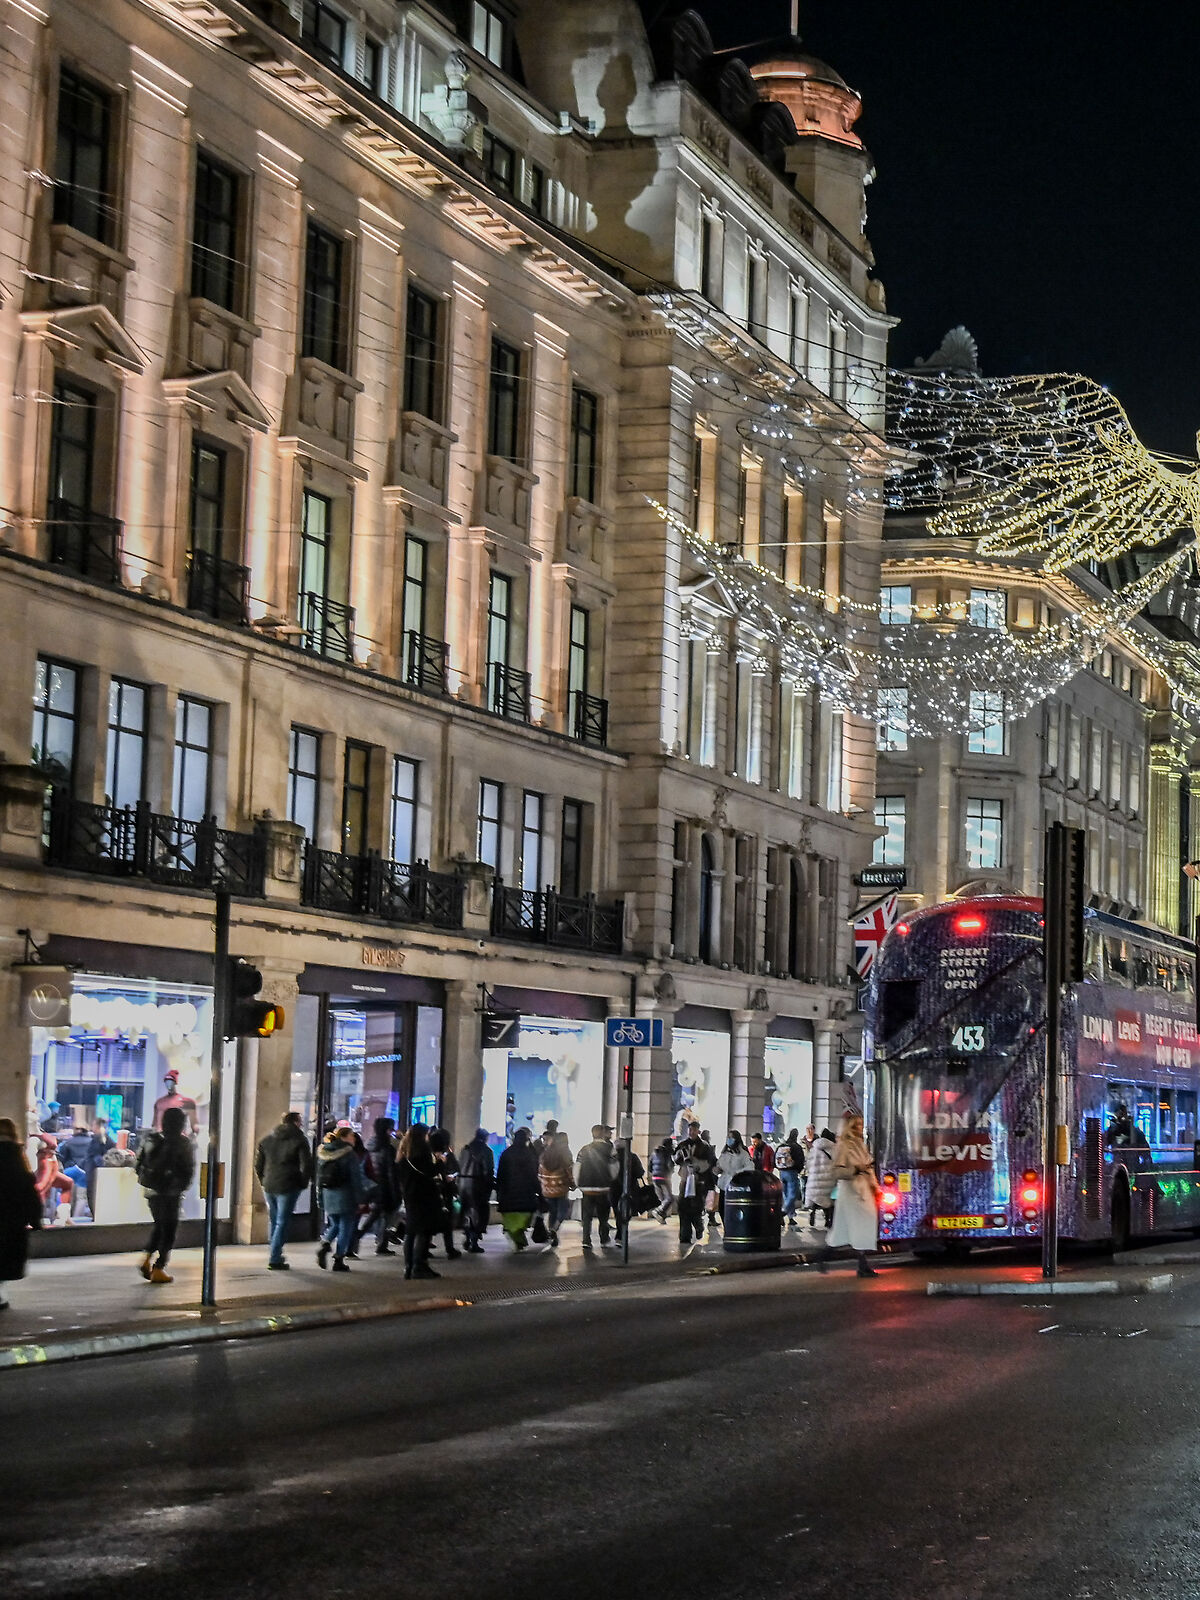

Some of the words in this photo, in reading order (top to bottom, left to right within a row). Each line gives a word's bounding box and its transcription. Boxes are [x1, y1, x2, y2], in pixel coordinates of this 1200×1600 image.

[940, 948, 990, 957] REGENT
[940, 958, 987, 967] STREET
[948, 968, 976, 977] NOW
[944, 980, 977, 990] OPEN
[1083, 1015, 1102, 1040] LDN
[1145, 1013, 1172, 1038] REGENT
[952, 1026, 985, 1051] 453
[1156, 1044, 1172, 1066] NOW
[1173, 1047, 1192, 1069] OPEN
[920, 1112, 969, 1129] LDN
